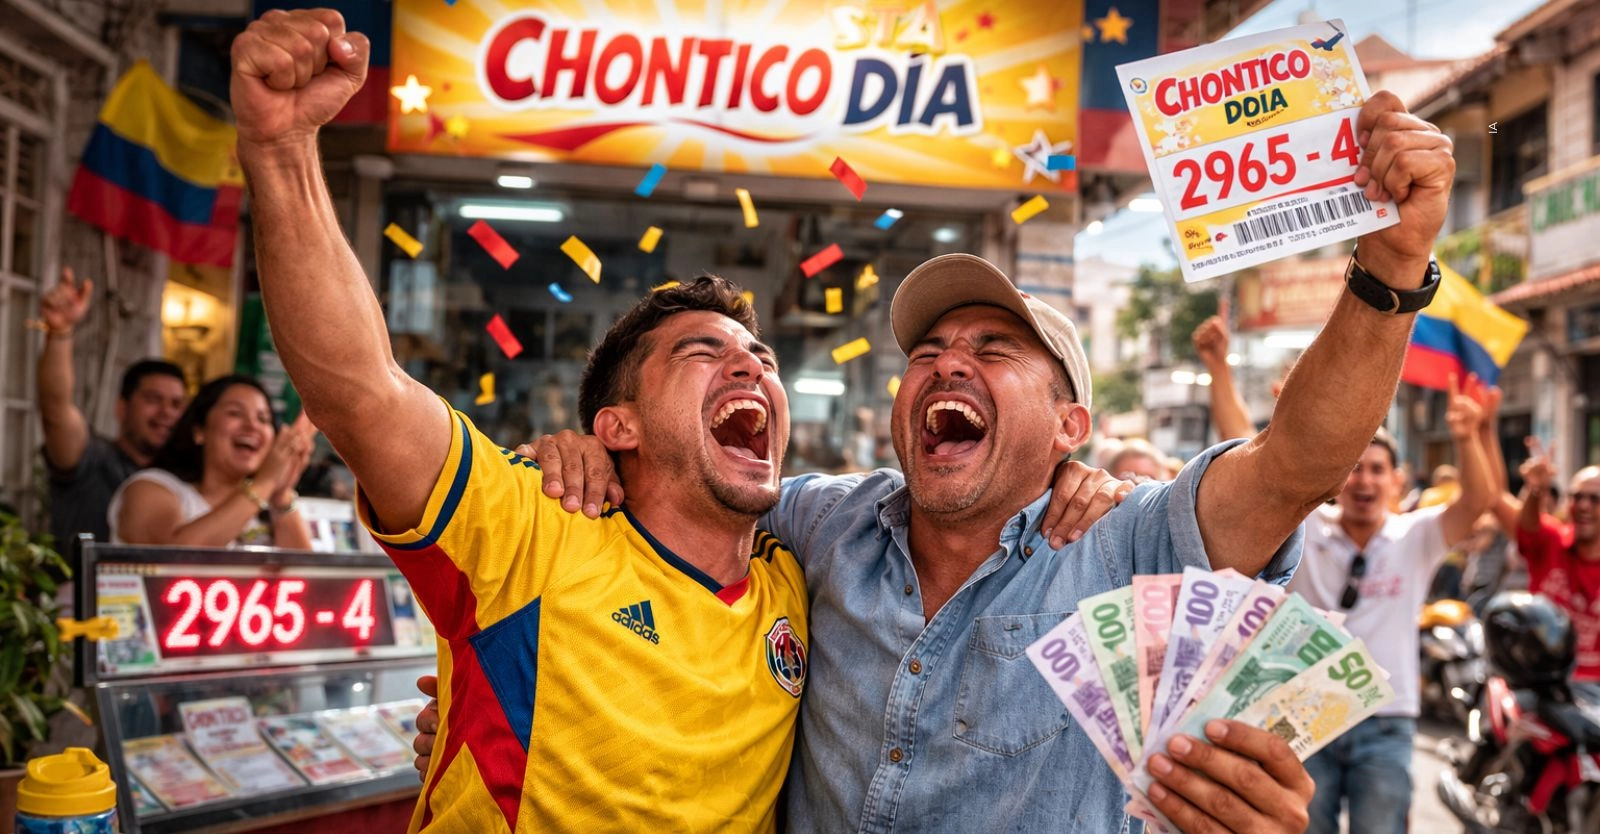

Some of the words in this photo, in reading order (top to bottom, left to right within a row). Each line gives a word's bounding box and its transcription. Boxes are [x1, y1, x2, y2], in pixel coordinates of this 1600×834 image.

[485, 16, 832, 116] CHONTICO
[1155, 50, 1311, 117] CHONTICO
[1173, 133, 1297, 211] 2965
[165, 578, 306, 648] 2965
[611, 611, 660, 645] adidas
[1185, 580, 1220, 626] 100
[1327, 651, 1374, 690] 50
